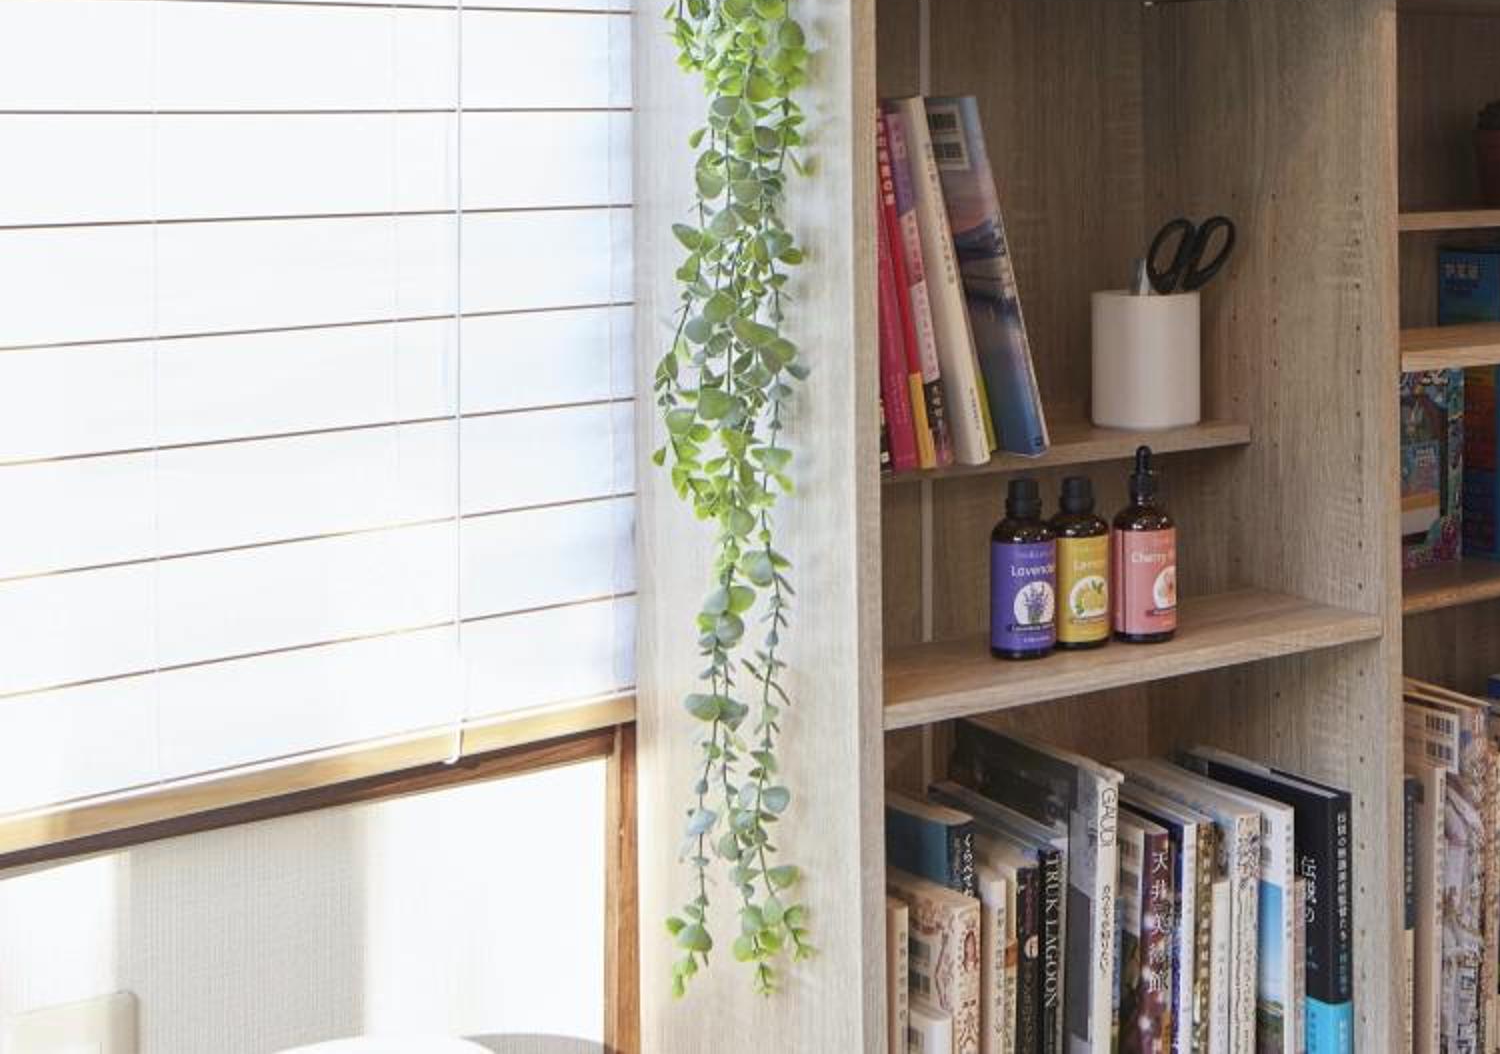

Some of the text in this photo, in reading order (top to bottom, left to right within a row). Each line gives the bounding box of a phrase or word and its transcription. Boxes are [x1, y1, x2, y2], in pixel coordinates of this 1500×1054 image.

[1011, 564, 1056, 577] Lavende
[1044, 854, 1059, 1008] TRUK LAGOON
